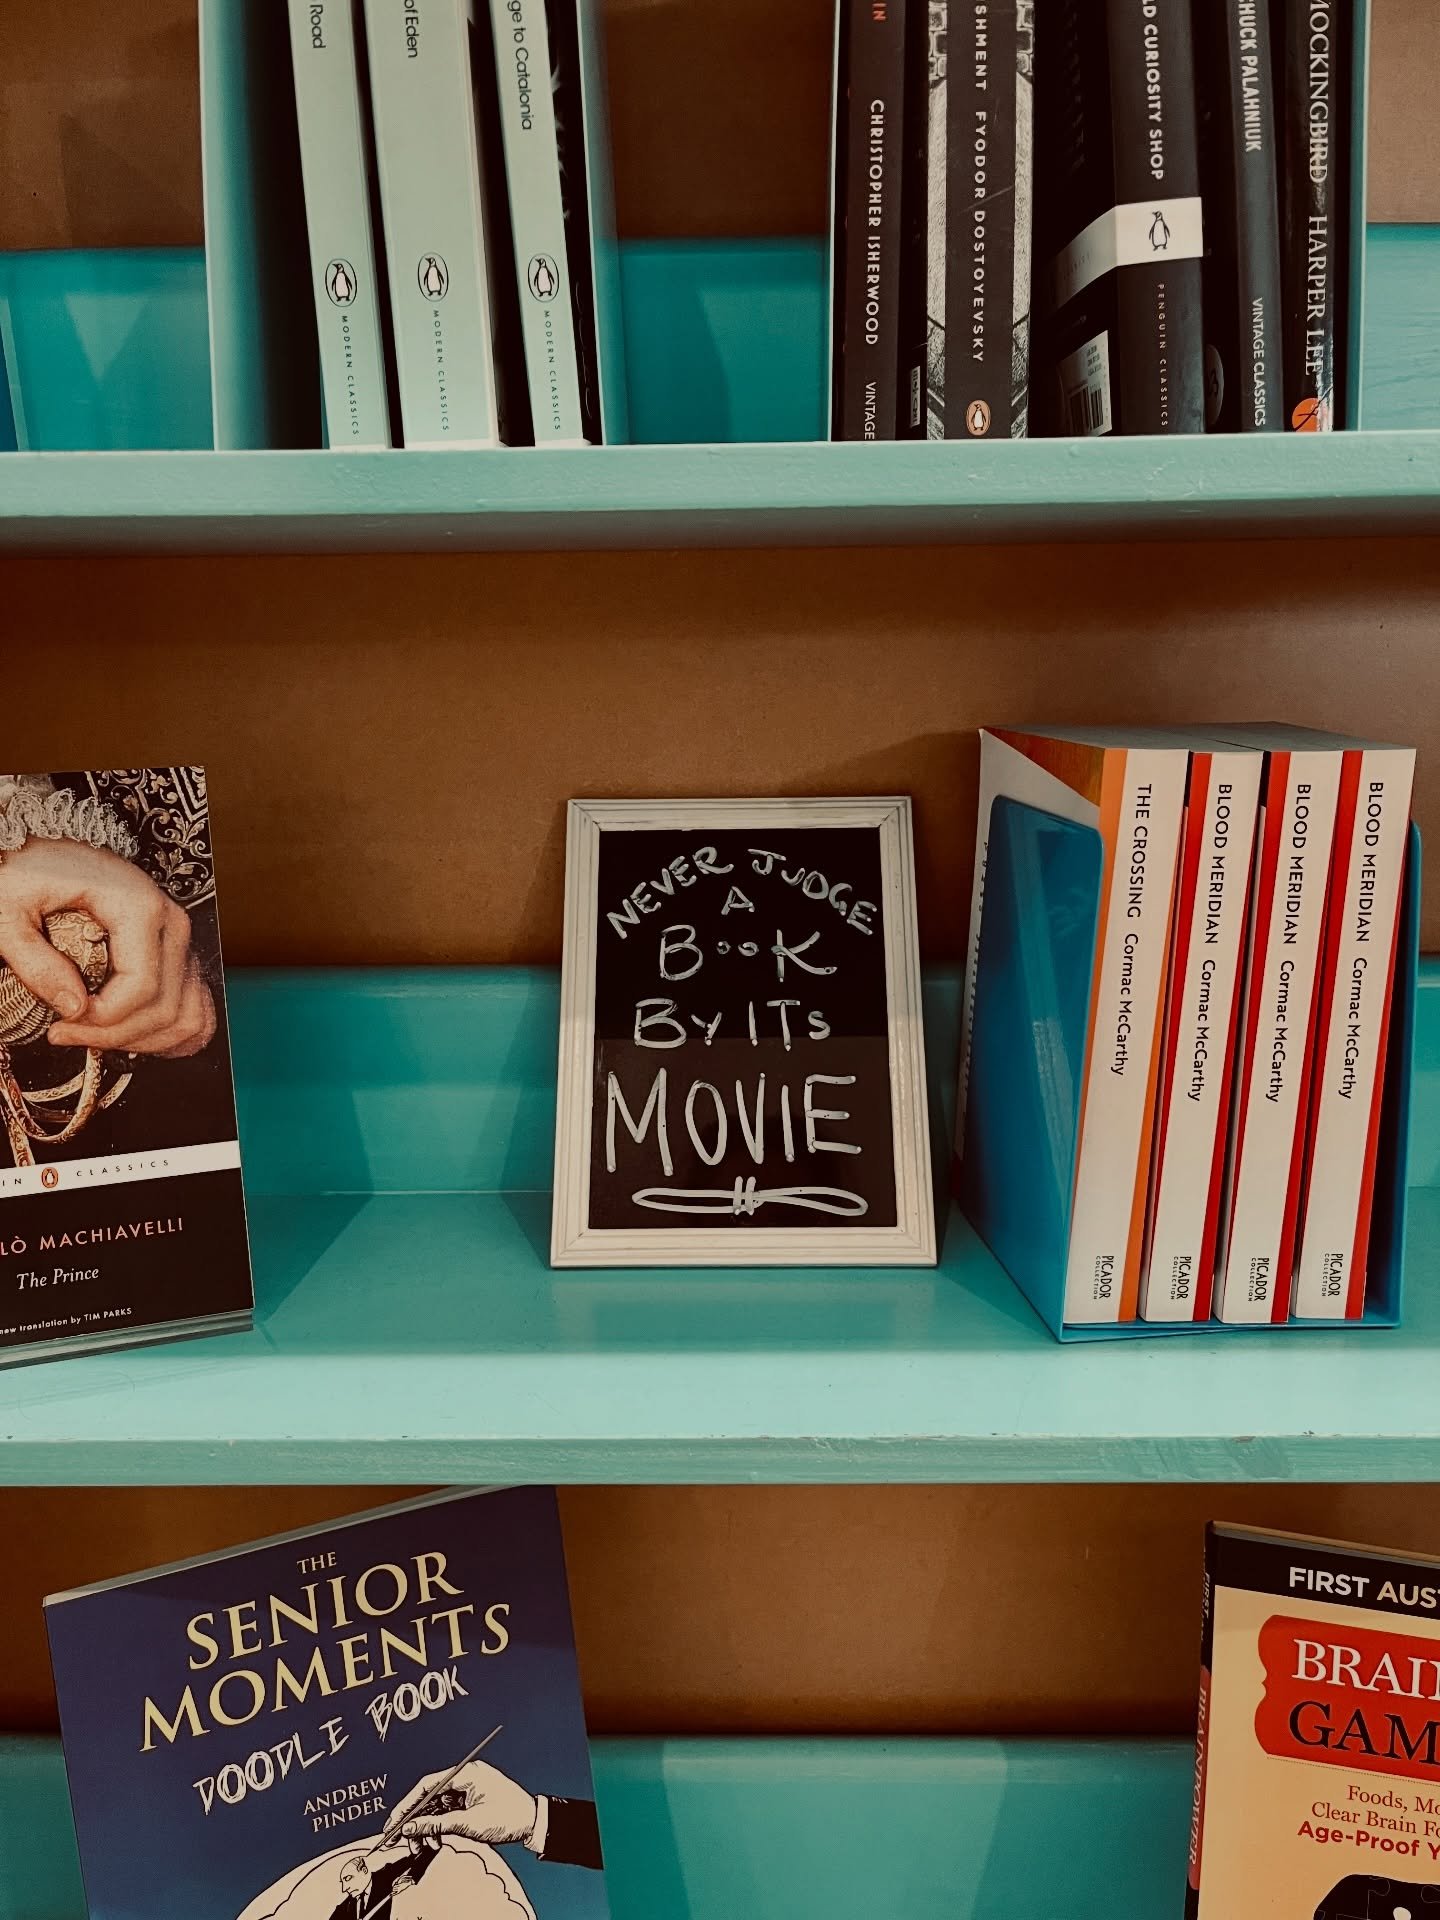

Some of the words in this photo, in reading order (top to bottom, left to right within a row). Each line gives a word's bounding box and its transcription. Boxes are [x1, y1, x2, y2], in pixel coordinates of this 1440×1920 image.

[310, 3, 325, 49] Road
[404, 0, 418, 13] of
[406, 16, 418, 59] Eden
[513, 27, 526, 44] to
[1238, 0, 1258, 51] HUCK
[974, 0, 988, 91] SHMENT
[1143, 23, 1162, 122] CURIOSITY
[515, 47, 532, 131] Catalonia
[1241, 55, 1262, 153] PALAHNIUK
[867, 100, 886, 227] CHRISTOPHER
[973, 110, 987, 200] FYODOR
[1148, 128, 1164, 180] SHOP
[865, 235, 882, 346] ISHERWOOD
[972, 210, 987, 362] DOSTOYEVSKY
[1306, 216, 1328, 322] HARPER
[433, 309, 445, 364] MODERN
[543, 310, 555, 363] MODERN
[1157, 283, 1167, 350] PENGUIN
[1251, 297, 1265, 360] VINTAGE
[340, 315, 354, 369] MODERN
[347, 375, 360, 436] CLASSICS
[1305, 329, 1325, 376] LEE
[437, 370, 450, 432] CLASSICS
[548, 369, 561, 431] CLASSICS
[864, 381, 877, 440] VINTAGE
[1159, 358, 1169, 427] CLASSICS
[1252, 361, 1266, 427] CLASSICS
[1134, 783, 1153, 820] THE
[1213, 784, 1233, 850] BLOOD
[1291, 784, 1312, 850] BLOOD
[1363, 782, 1384, 848] BLOOD
[606, 845, 734, 940] NEVER
[746, 847, 877, 936] JUDGE
[720, 885, 756, 916] A
[1126, 825, 1149, 919] CROSSING
[1204, 856, 1228, 945] MERIDIAN
[1283, 856, 1307, 945] MERIDIAN
[1355, 854, 1378, 943] MERIDIAN
[1118, 933, 1140, 996] Cormac
[1195, 959, 1217, 1021] Cormac
[1273, 960, 1295, 1021] Cormac
[1346, 957, 1368, 1018] Cormac
[1110, 1000, 1133, 1076] McCarthy
[1186, 1026, 1211, 1102] McCarthy
[1264, 1027, 1289, 1103] McCarthy
[1337, 1024, 1362, 1100] McCarthy
[605, 1067, 862, 1177] MOVIE
[76, 1159, 169, 1177] CLASSICS
[39, 1217, 183, 1251] MACHIAVELLI
[16, 1272, 47, 1290] The
[52, 1268, 99, 1285] Prince
[1093, 1255, 1101, 1300] COLLECTION
[1099, 1255, 1114, 1299] PICADOR
[1170, 1256, 1179, 1300] COLLECTION
[1176, 1256, 1192, 1300] PICADOR
[1248, 1257, 1257, 1302] COLLECTION
[1254, 1257, 1270, 1302] PICADOR
[1322, 1253, 1330, 1297] COLLECTION
[1328, 1252, 1344, 1297] PICADOR
[20, 1318, 68, 1332] translation
[70, 1316, 81, 1325] by
[84, 1312, 100, 1322] TIM
[103, 1307, 132, 1319] PARKS
[296, 1551, 337, 1575] THE
[1288, 1566, 1370, 1599] FIRST
[1376, 1580, 1440, 1609] AUS
[186, 1551, 464, 1671] SENIOR
[139, 1603, 511, 1753] MOMENTS
[192, 1715, 350, 1816] DOODLE
[365, 1664, 470, 1742] BOOK
[1288, 1699, 1440, 1766] GAM
[303, 1773, 389, 1816] ANDREW
[1189, 1687, 1207, 1866] BRAINPOWER
[1347, 1784, 1408, 1813] Foods,
[312, 1796, 388, 1833] PINDER
[1297, 1820, 1420, 1857] Age-Proof
[1311, 1801, 1360, 1824] Clear
[1366, 1810, 1417, 1834] Brain
